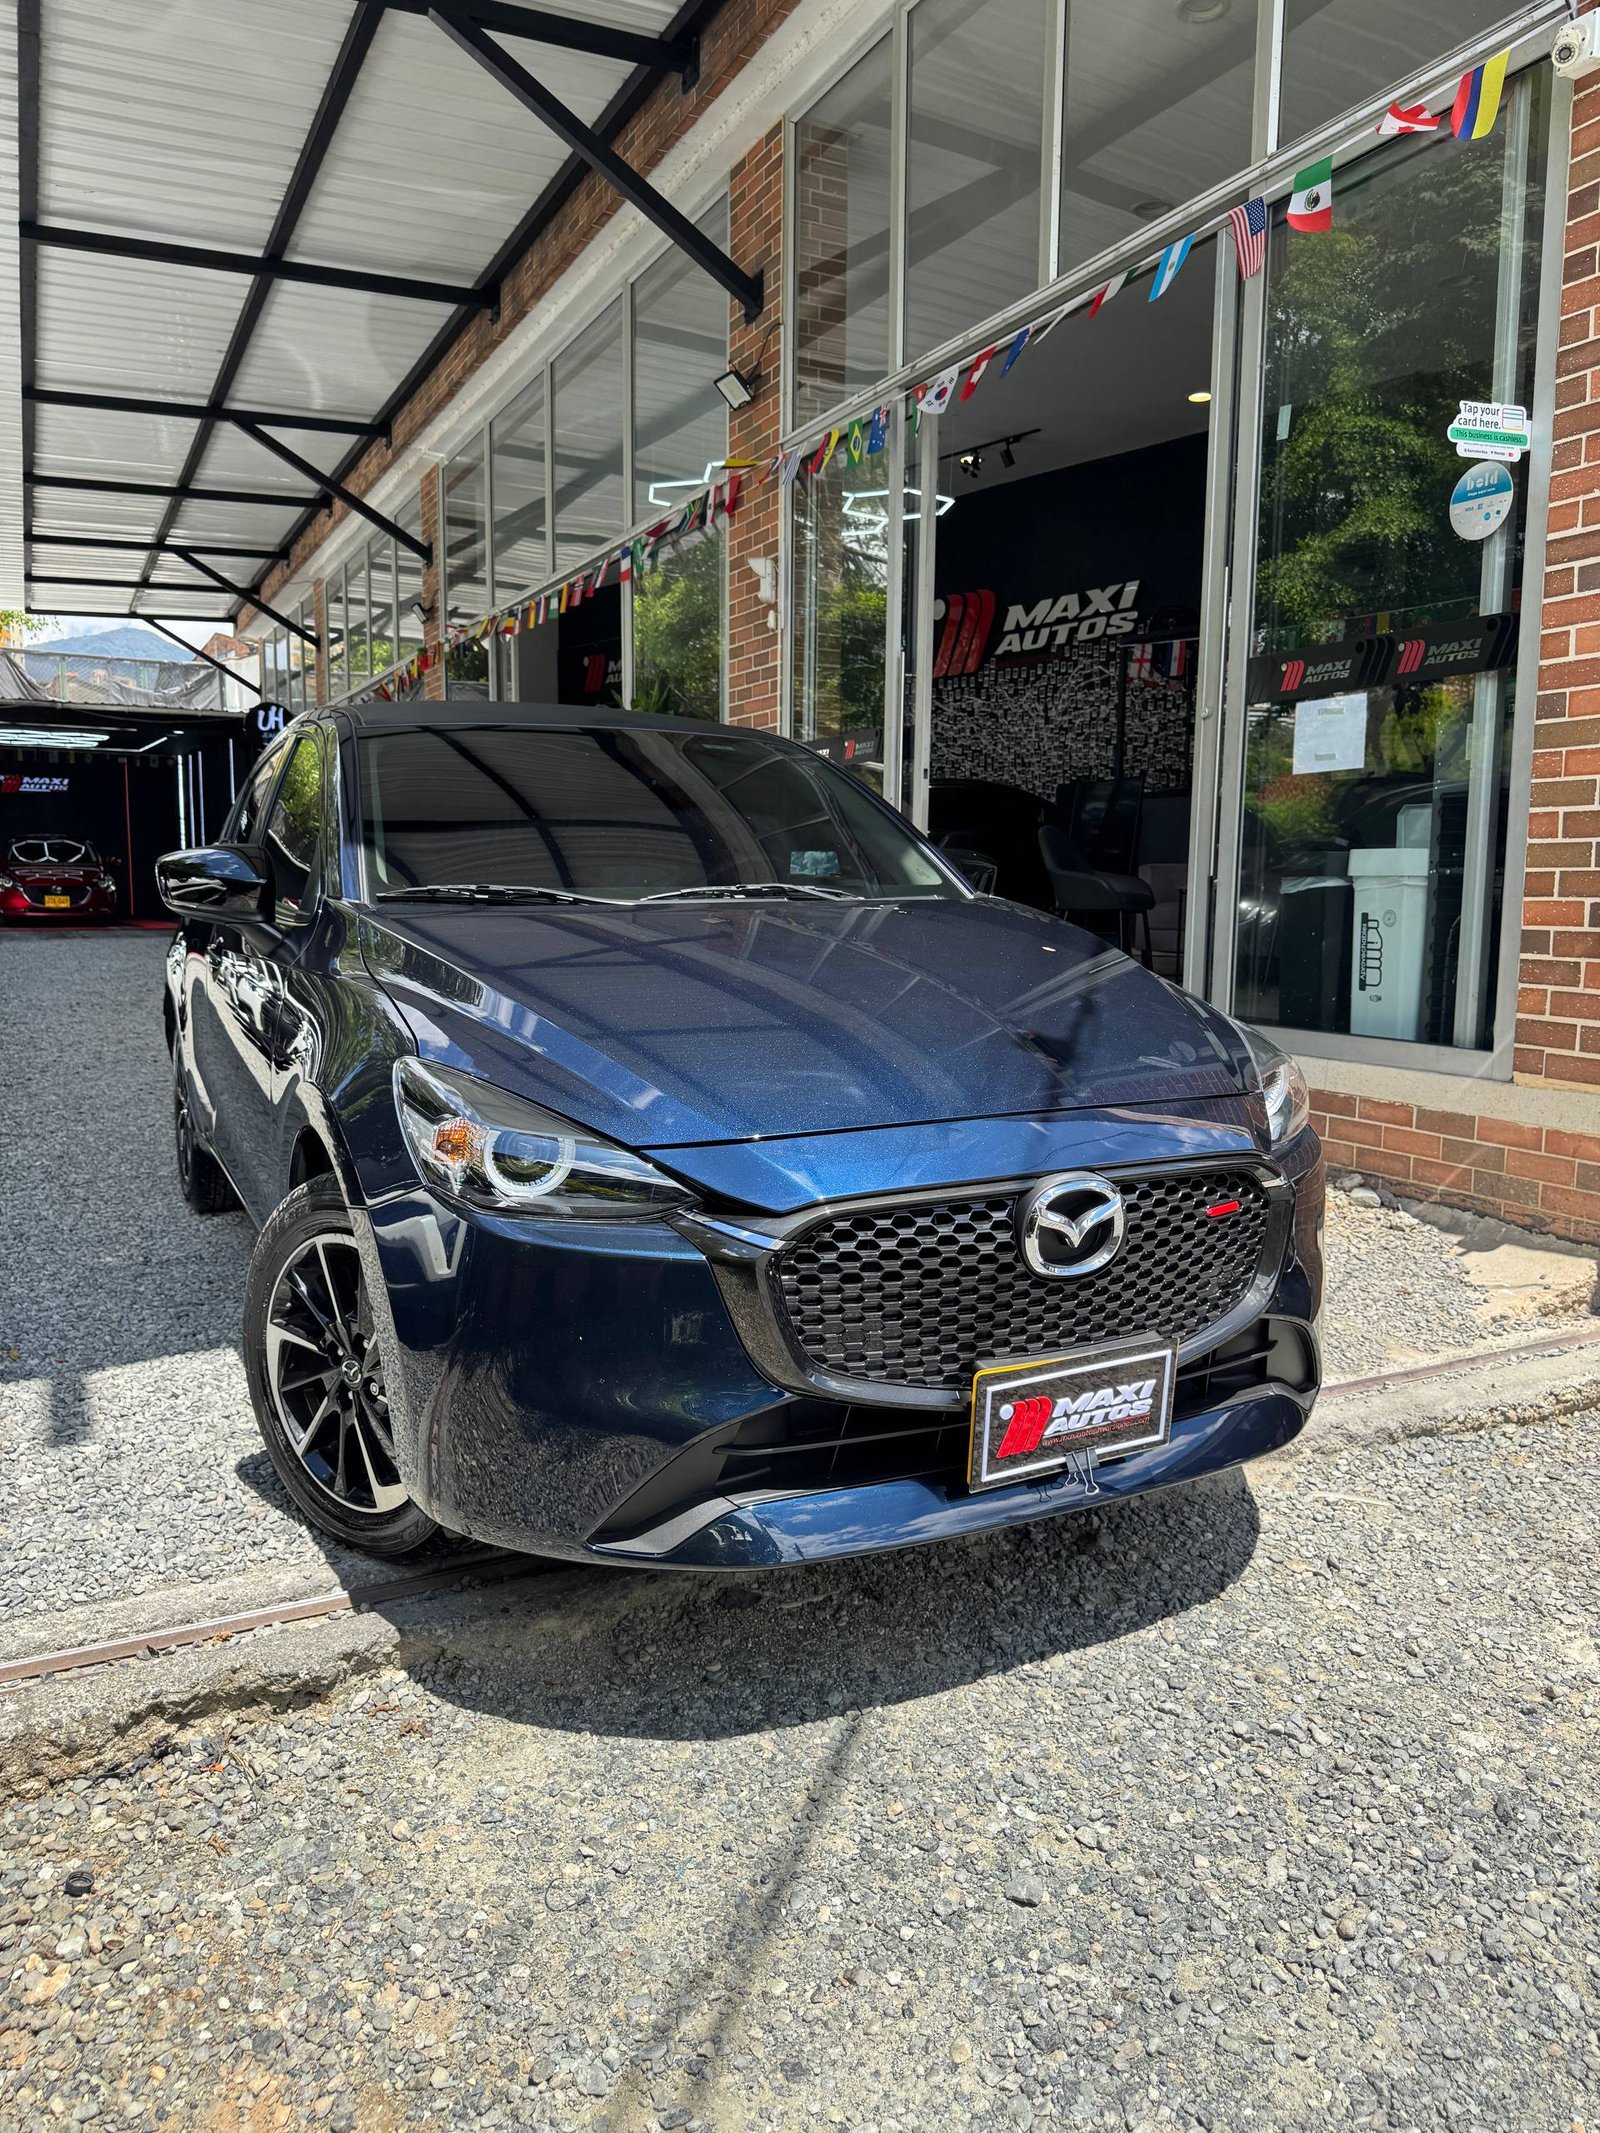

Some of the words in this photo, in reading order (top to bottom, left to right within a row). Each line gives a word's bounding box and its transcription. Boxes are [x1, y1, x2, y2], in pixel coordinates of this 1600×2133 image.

[1463, 403, 1478, 416] Tap
[1480, 406, 1500, 417] your
[1457, 417, 1477, 427] card
[1479, 418, 1501, 429] here.
[1456, 430, 1467, 438] This
[1469, 431, 1492, 440] business
[1466, 470, 1498, 491] bold
[1003, 580, 1140, 632] MAXI
[994, 611, 1138, 655] AUTOS
[1427, 638, 1482, 656] MAXI
[1424, 649, 1480, 666] AUTOS
[1306, 659, 1351, 675] MAXI
[1303, 669, 1351, 684] AUTOS
[20, 783, 69, 791] AUTOS
[22, 776, 70, 785] MAXI
[1052, 1379, 1156, 1418] MAXI
[1044, 1399, 1152, 1436] AUTOS
